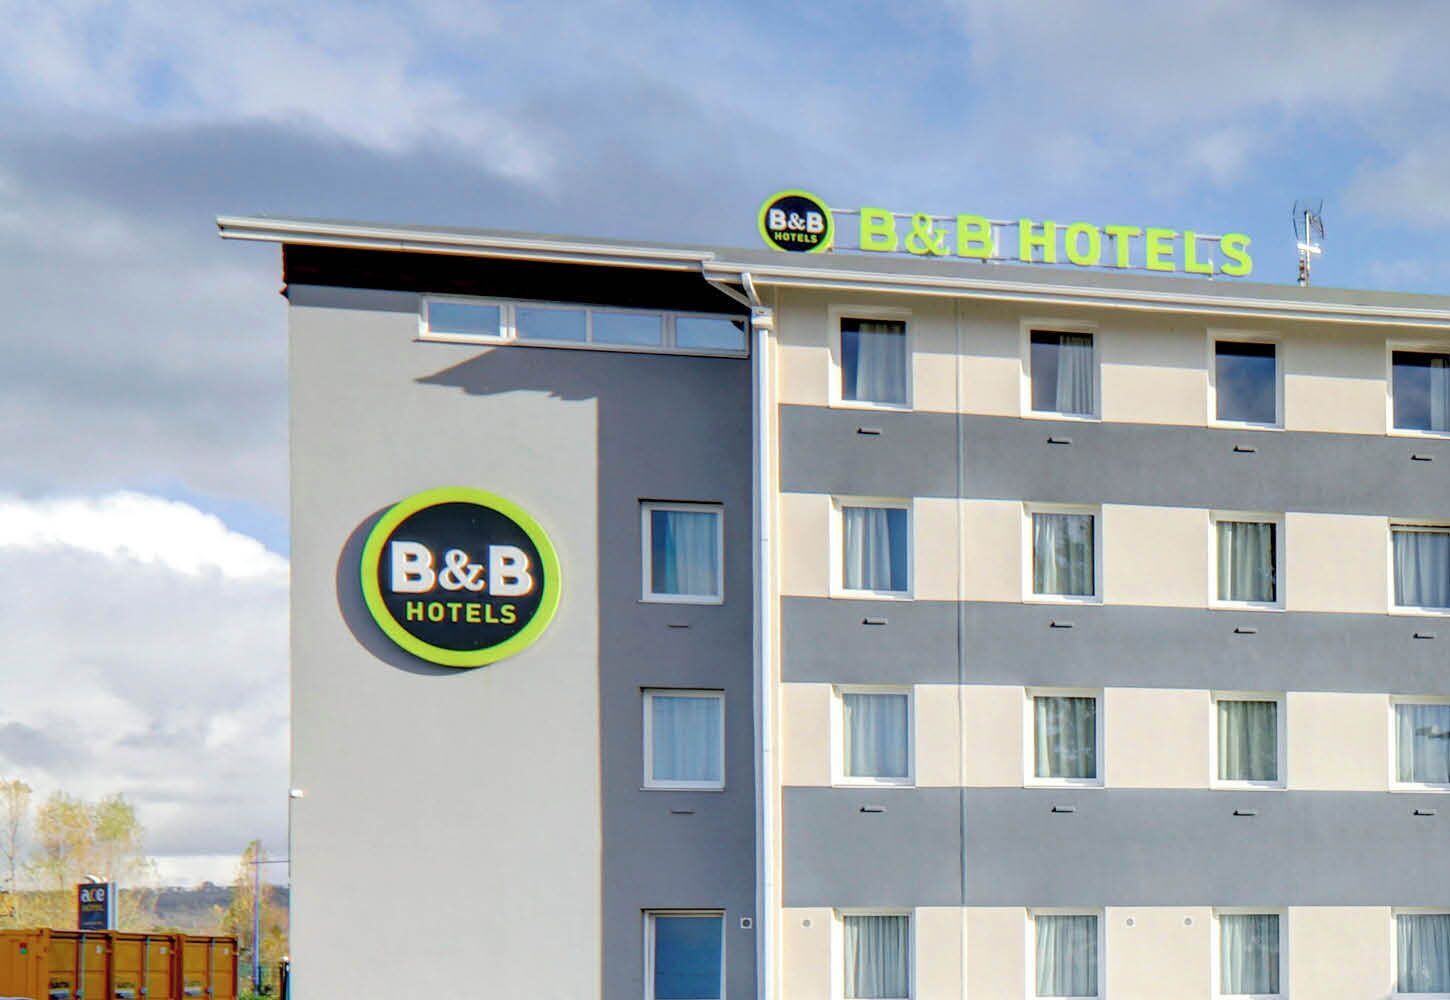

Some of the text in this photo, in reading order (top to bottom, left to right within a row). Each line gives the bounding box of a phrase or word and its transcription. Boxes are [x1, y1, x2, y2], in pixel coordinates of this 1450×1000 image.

[769, 208, 825, 233] B&B
[774, 231, 818, 244] HOTELS
[860, 207, 1253, 276] B&B HOTELS
[390, 541, 536, 597] B&B
[406, 601, 517, 624] HOTELS
